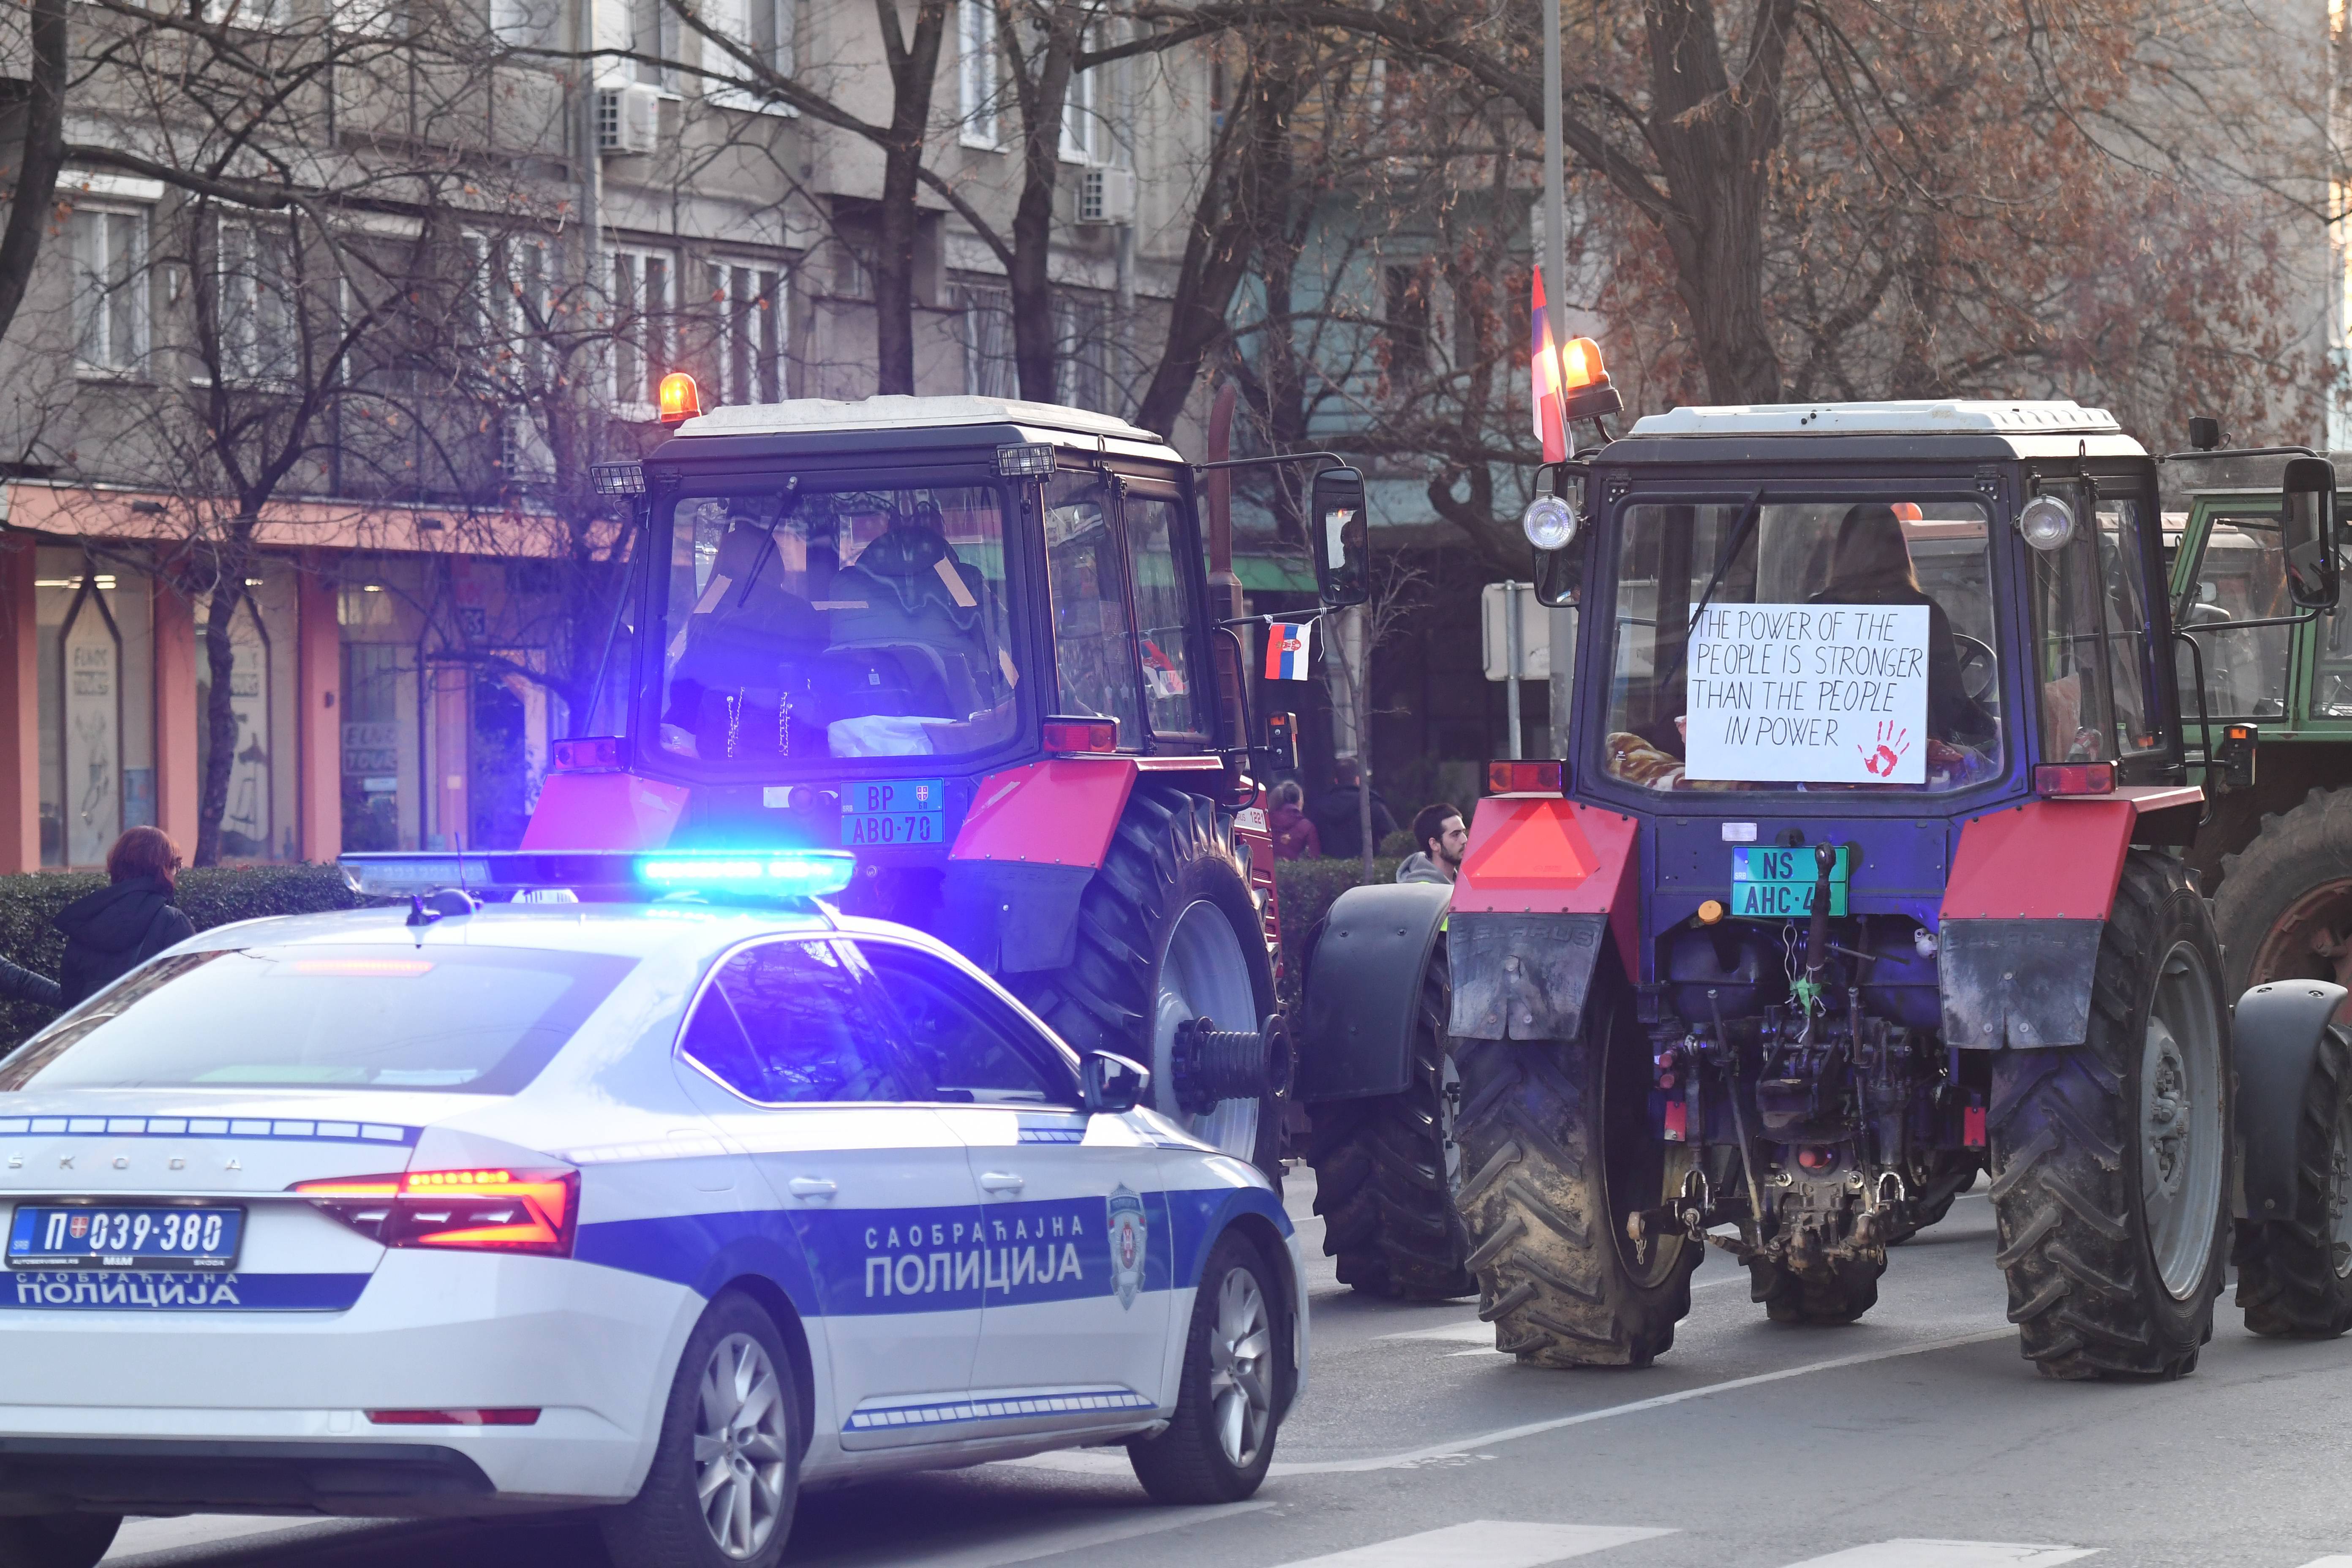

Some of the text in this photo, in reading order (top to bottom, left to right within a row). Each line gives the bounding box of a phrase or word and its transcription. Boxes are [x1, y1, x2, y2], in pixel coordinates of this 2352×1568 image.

[1695, 610, 1898, 642] THE POWER OF THE
[1697, 643, 1923, 678] PEOPLE IS STRONGER
[1692, 679, 1897, 712] THAN THE PEOPLE
[1724, 716, 1838, 747] IN POWER
[868, 786, 893, 811] BP
[1250, 811, 1264, 825] 1221
[1763, 852, 1794, 879] NS
[1454, 925, 1595, 947] BELARUS
[864, 1215, 1083, 1250] САОБРАЋАЈНА
[16, 1273, 238, 1284] САОБРАЋАЈНА
[865, 1243, 1083, 1298] ПОЛИЦИЈА
[16, 1283, 240, 1307] ПОЛИЦИЈА
